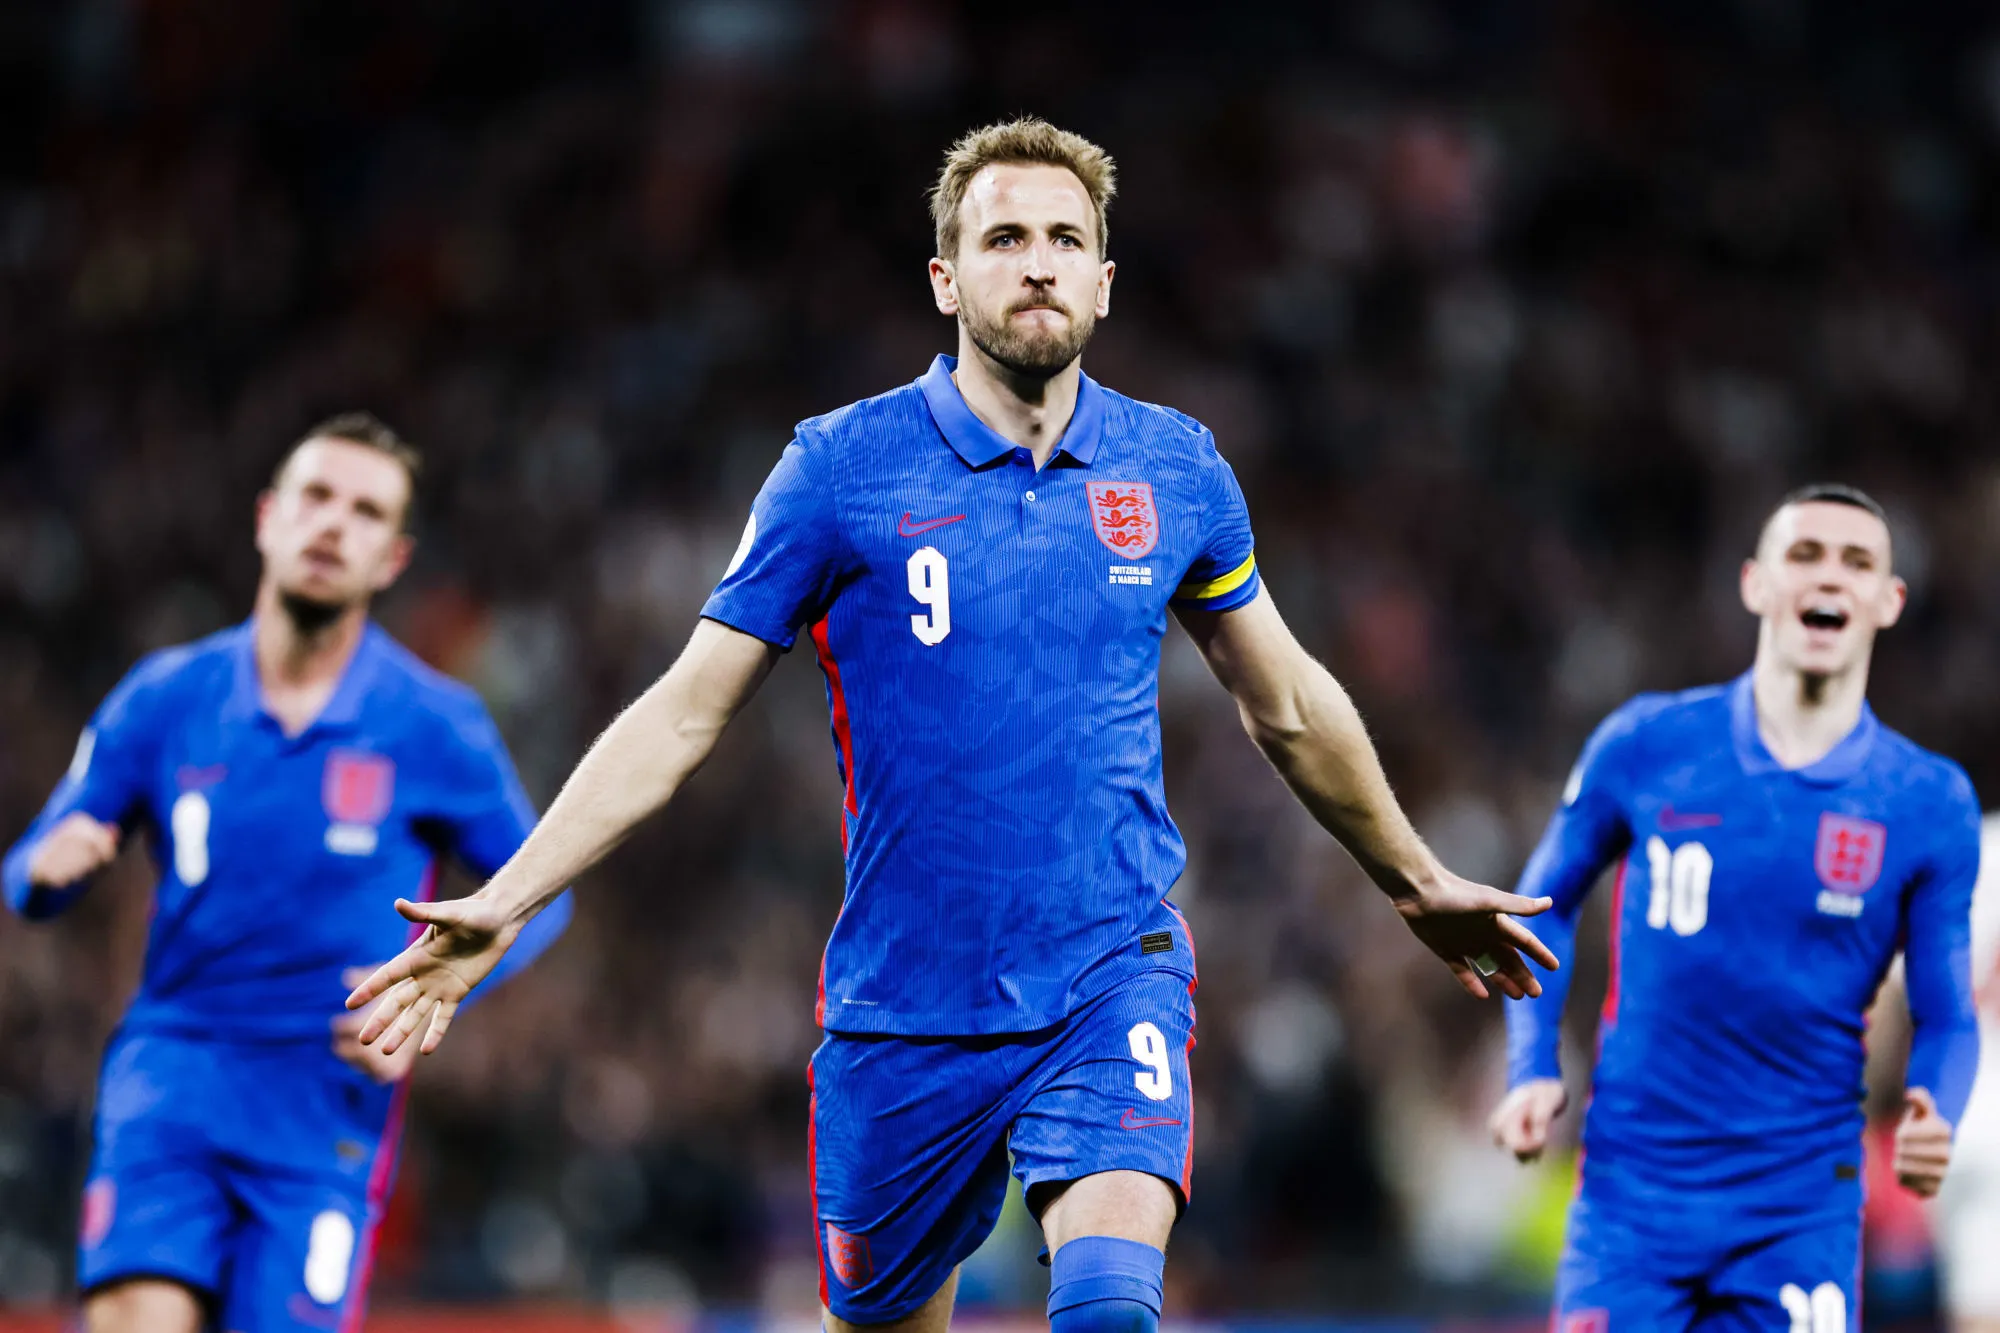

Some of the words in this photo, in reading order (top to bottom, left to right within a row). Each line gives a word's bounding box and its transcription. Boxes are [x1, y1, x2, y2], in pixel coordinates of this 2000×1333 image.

[907, 546, 951, 646] 9
[1109, 565, 1152, 576] SWITZERLAND
[1117, 575, 1139, 585] MARCH
[1647, 835, 1713, 936] 10
[1128, 1021, 1173, 1102] 9
